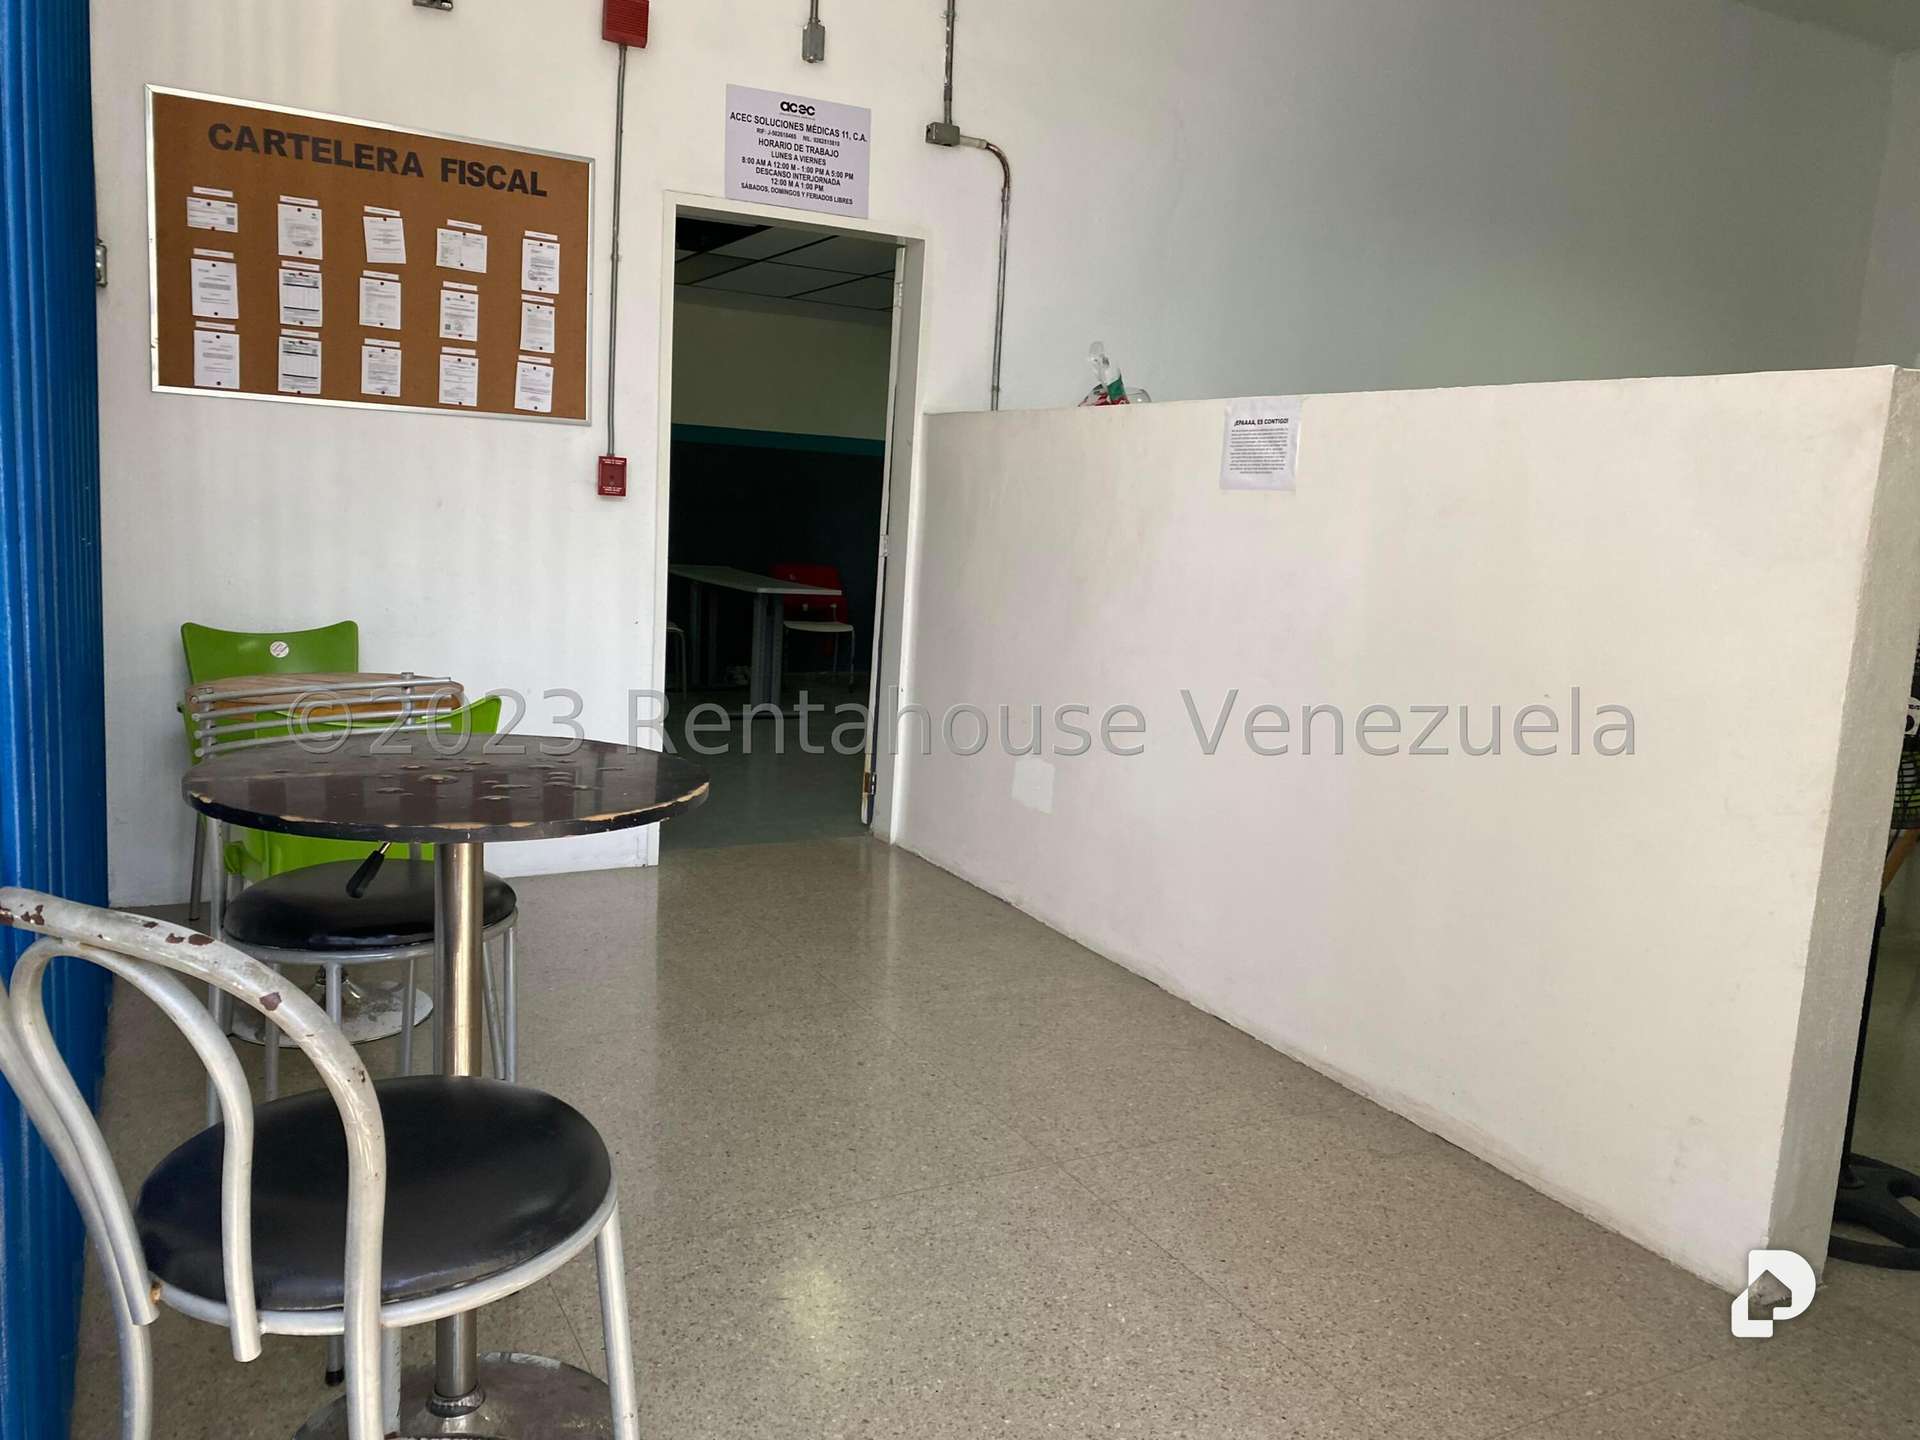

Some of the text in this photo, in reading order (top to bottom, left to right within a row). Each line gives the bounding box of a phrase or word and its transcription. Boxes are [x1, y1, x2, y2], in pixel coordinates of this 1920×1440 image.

[780, 100, 815, 116] acec
[730, 112, 752, 123] ACEC
[754, 116, 804, 131] SOLUCIONES
[806, 123, 839, 138] MÉDICAS
[853, 132, 868, 142] C.A.
[758, 138, 839, 158] HORARIO DE TRABAJO
[208, 122, 547, 197] CARTELERA FISCAL
[742, 156, 754, 165] 8:00
[756, 159, 766, 167] AM
[774, 161, 789, 170] 12:00
[802, 165, 813, 174] 1:00
[832, 170, 843, 178] 5:00
[845, 172, 854, 180] PM
[771, 151, 792, 161] LUNES
[800, 155, 826, 166] VIERNES
[756, 167, 840, 186] DESCANSO INTERJORNADA
[771, 177, 787, 186] 12:00
[801, 182, 812, 190] 1:00
[814, 183, 824, 191] PM
[741, 182, 770, 193] SÁBADOS,
[771, 186, 800, 197] DOMINGOS
[806, 192, 833, 202] FERIADOS
[834, 196, 853, 205] LIBRES
